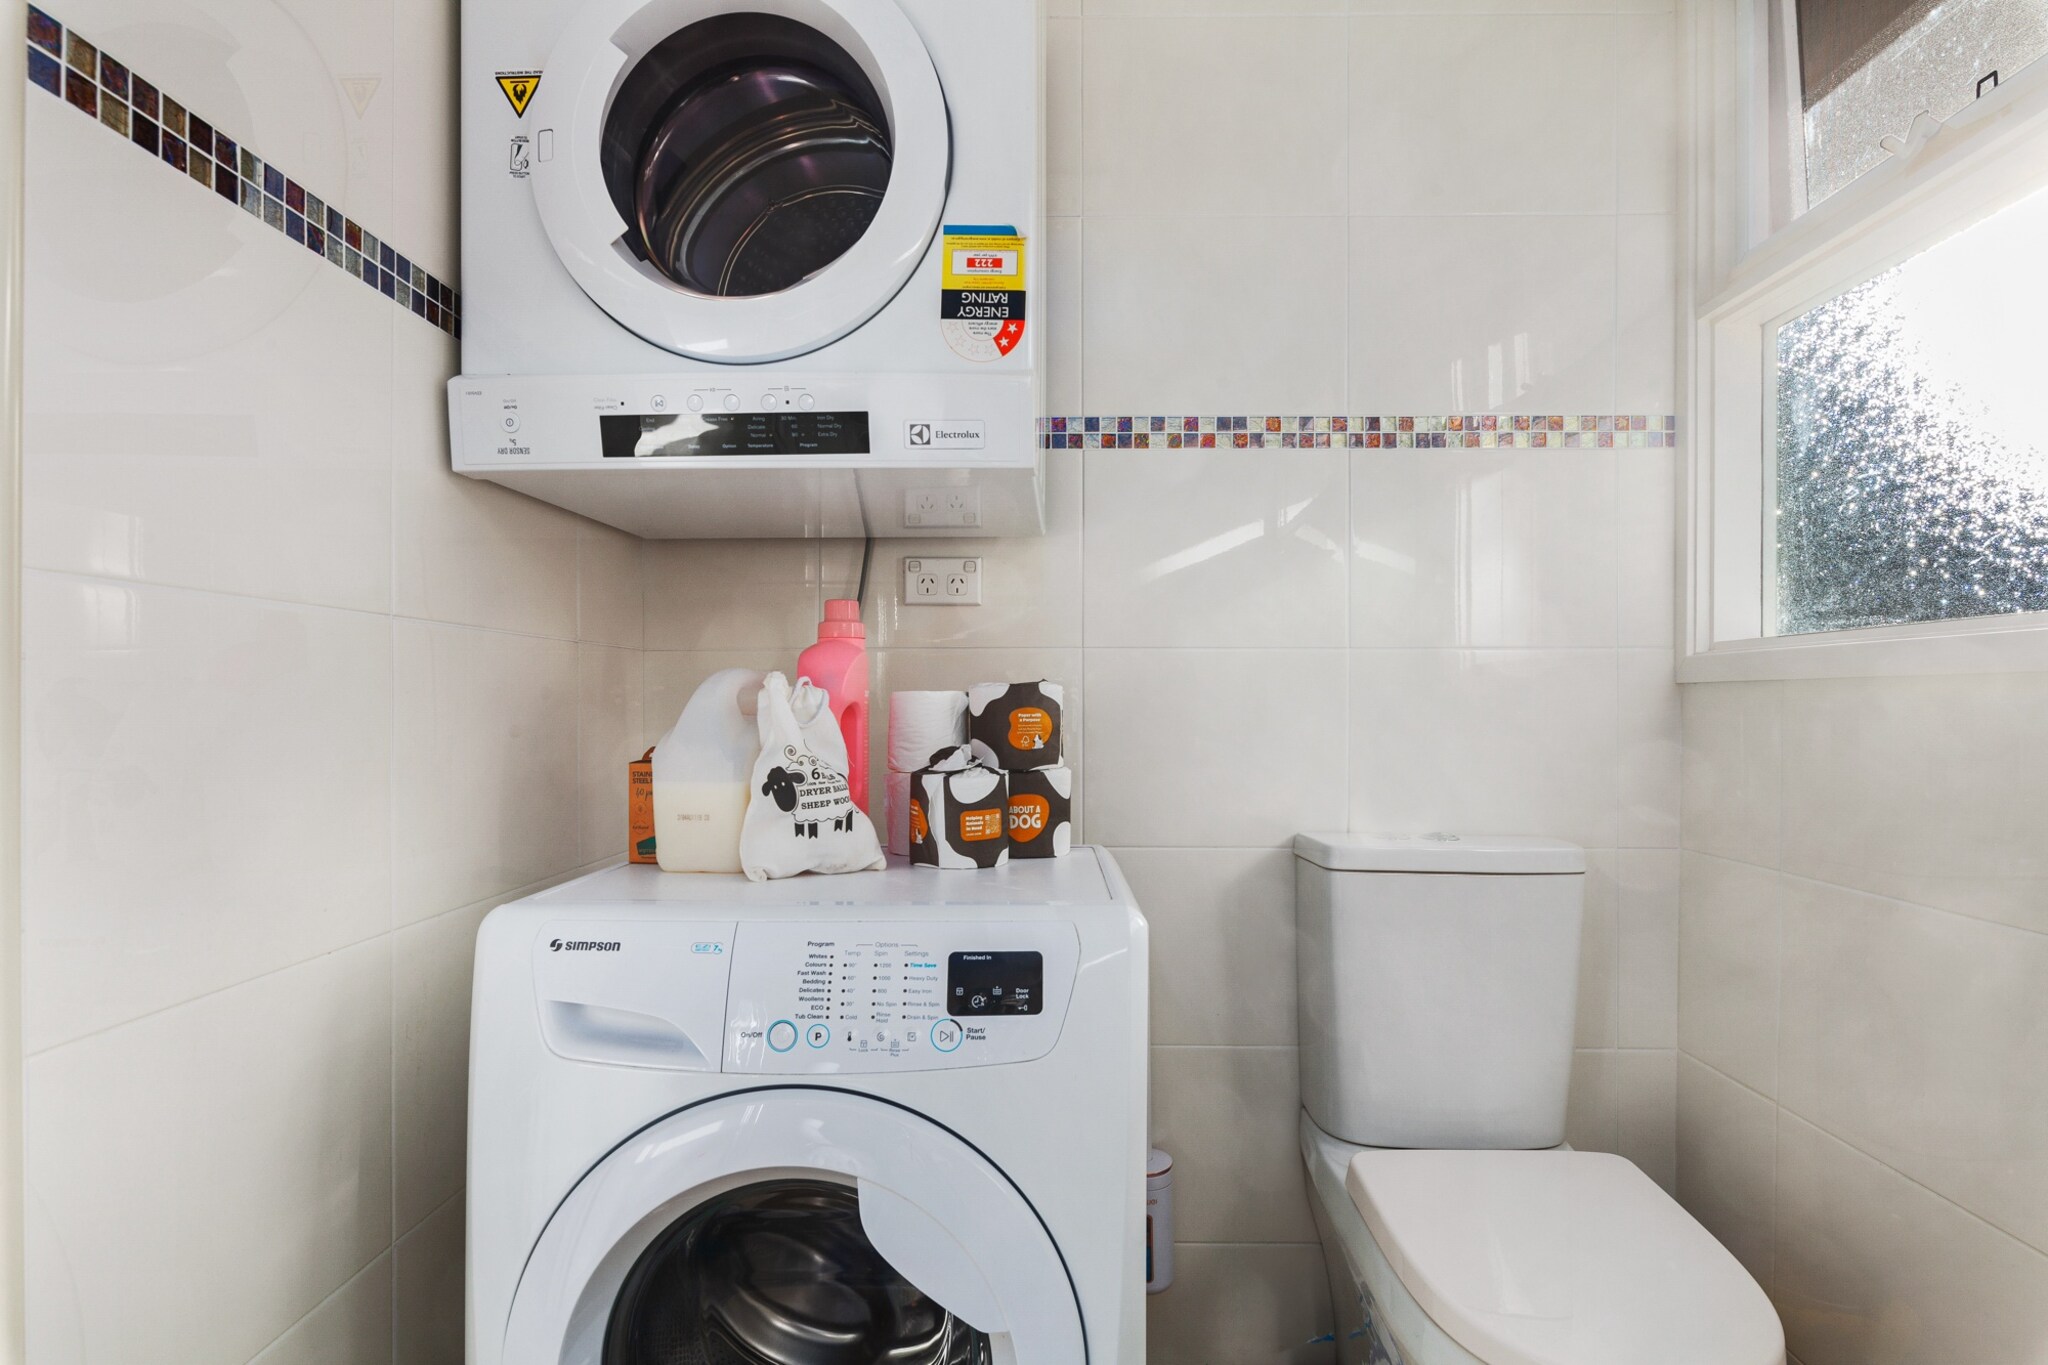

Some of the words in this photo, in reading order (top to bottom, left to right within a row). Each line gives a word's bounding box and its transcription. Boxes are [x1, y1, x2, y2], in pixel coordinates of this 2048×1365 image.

[974, 258, 993, 266] 222
[962, 292, 1008, 303] RATING
[957, 306, 1009, 318] ENERGY
[936, 430, 980, 438] Electrolux
[812, 768, 820, 780] 6
[800, 786, 831, 797] DRYER
[801, 800, 831, 810] SHEEP
[1009, 814, 1041, 829] DOG
[565, 942, 620, 951] SIMPSON
[815, 1032, 822, 1041] P
